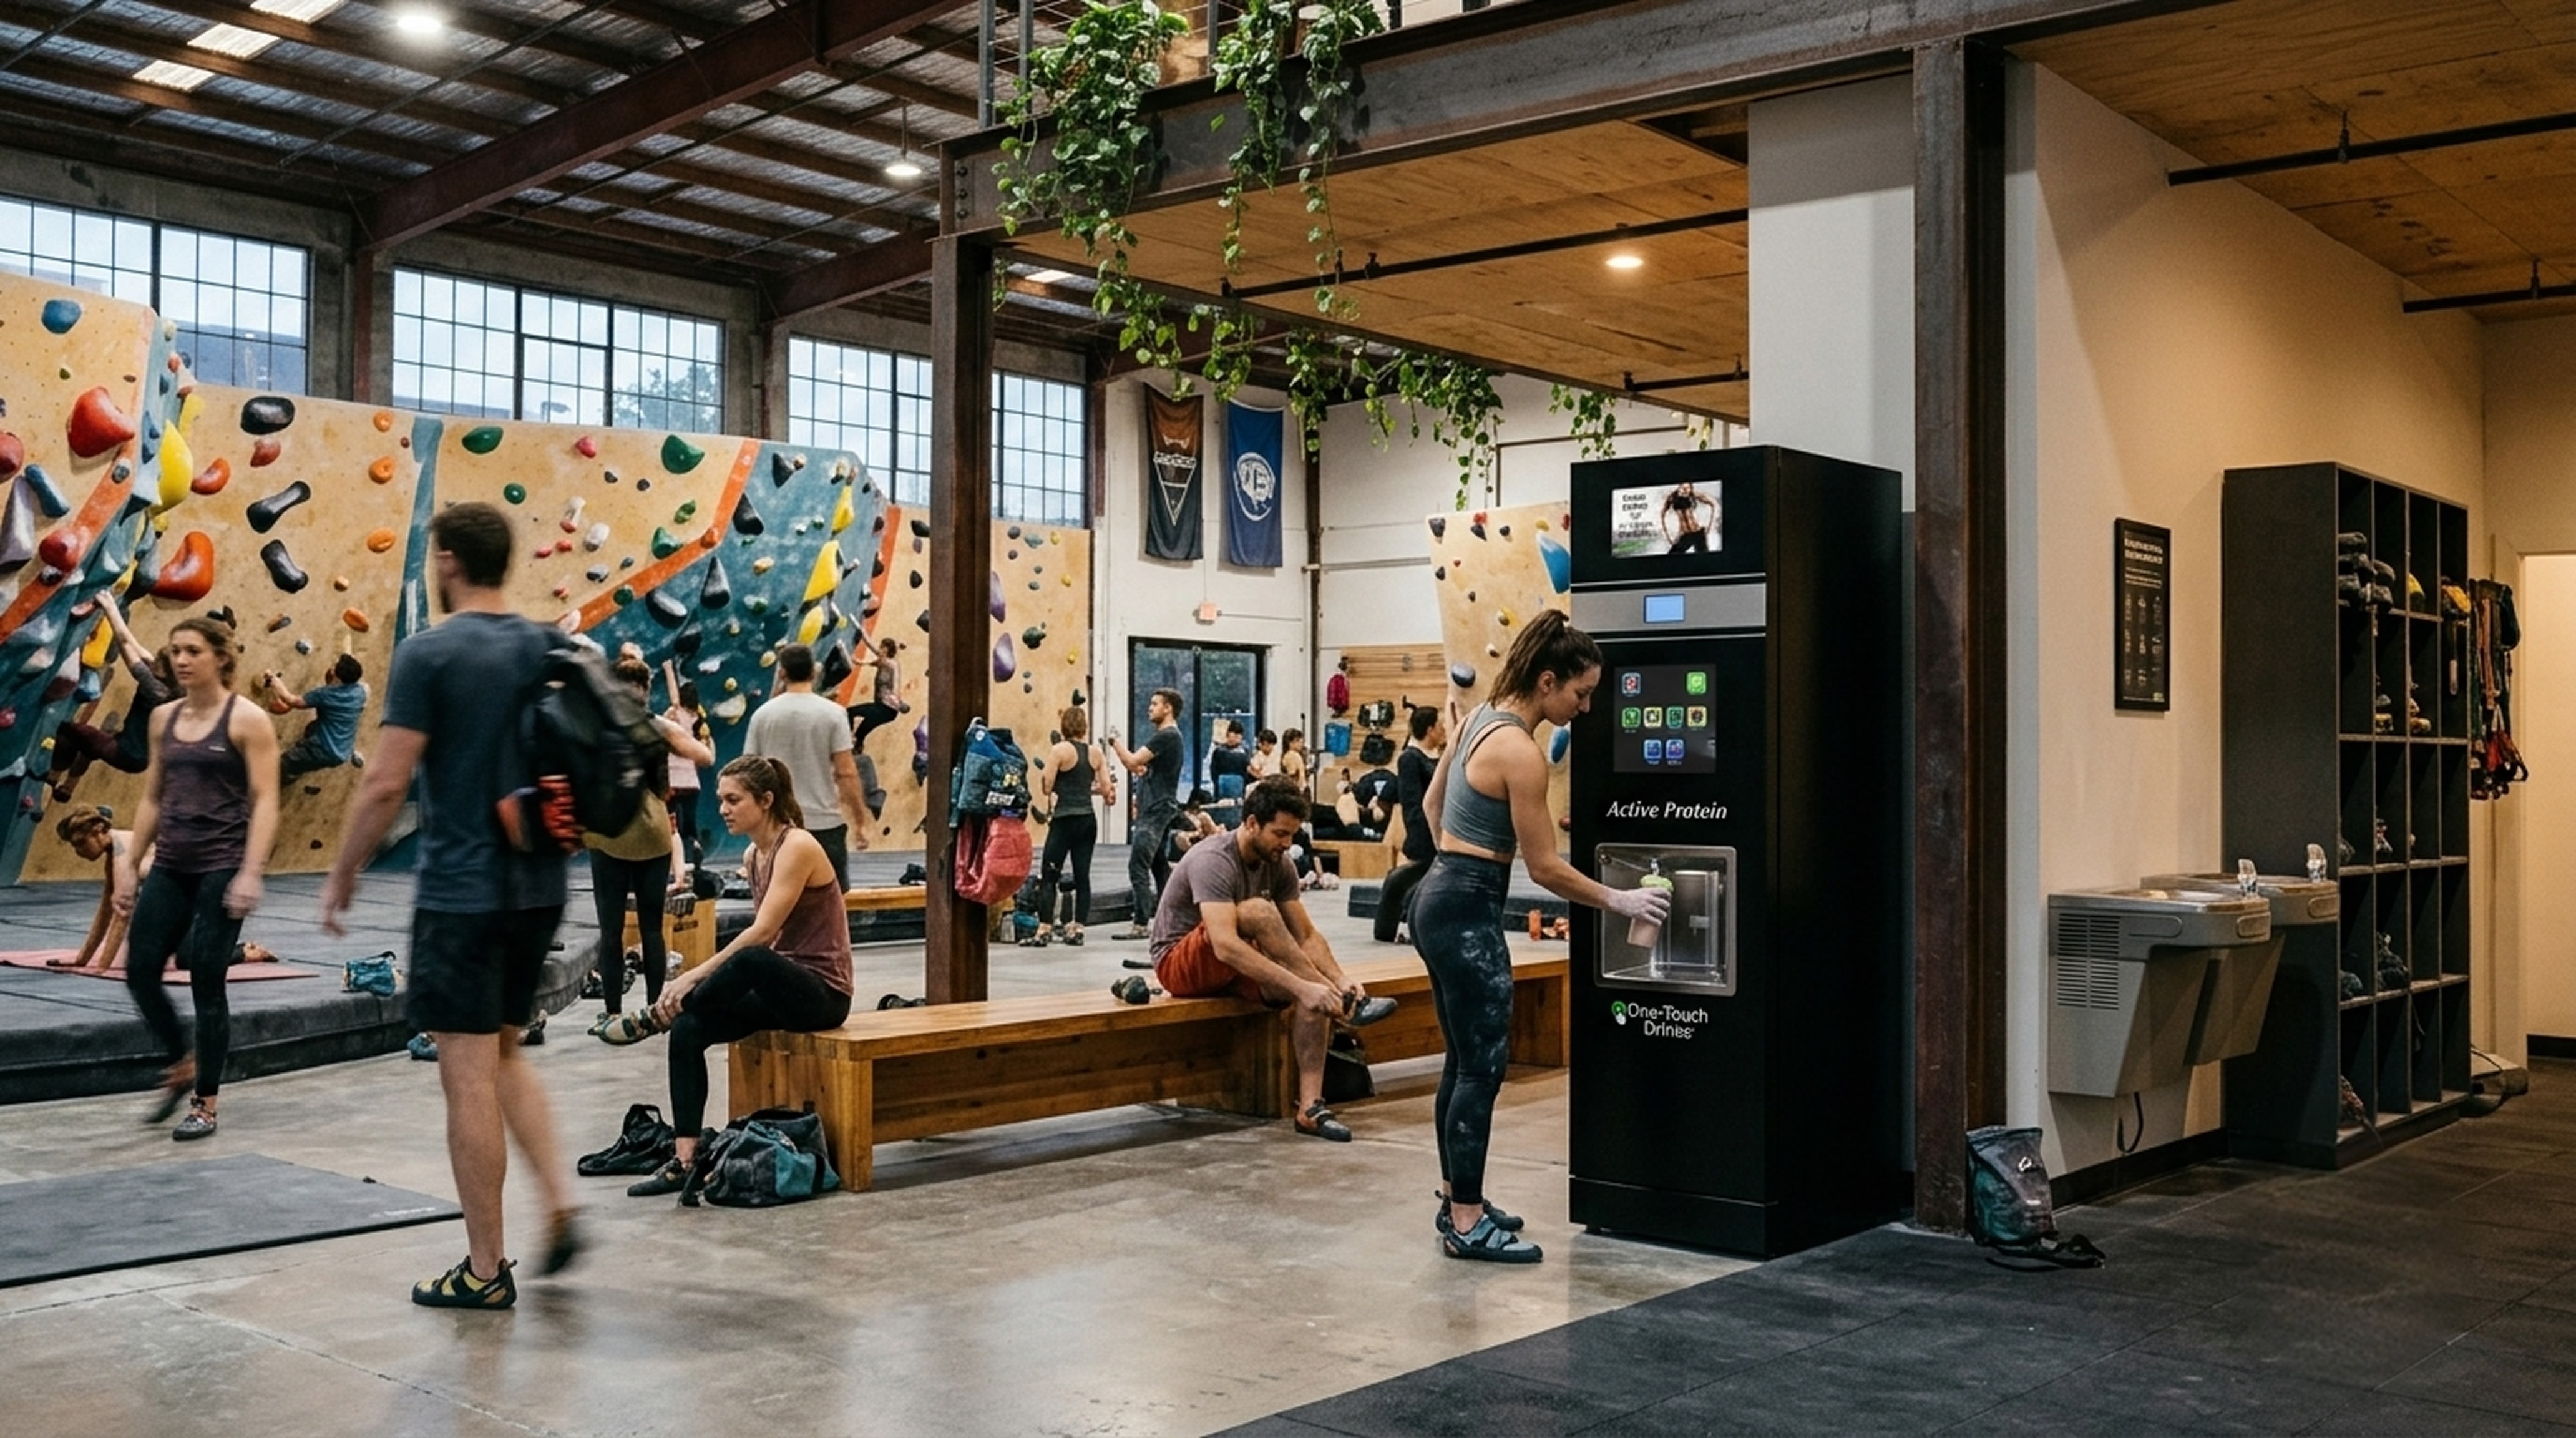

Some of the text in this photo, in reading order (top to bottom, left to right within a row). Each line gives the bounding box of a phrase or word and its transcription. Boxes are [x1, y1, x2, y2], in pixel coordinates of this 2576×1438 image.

[1606, 801, 1728, 819] Active Protein
[1627, 1002, 1709, 1024] One-Touch
